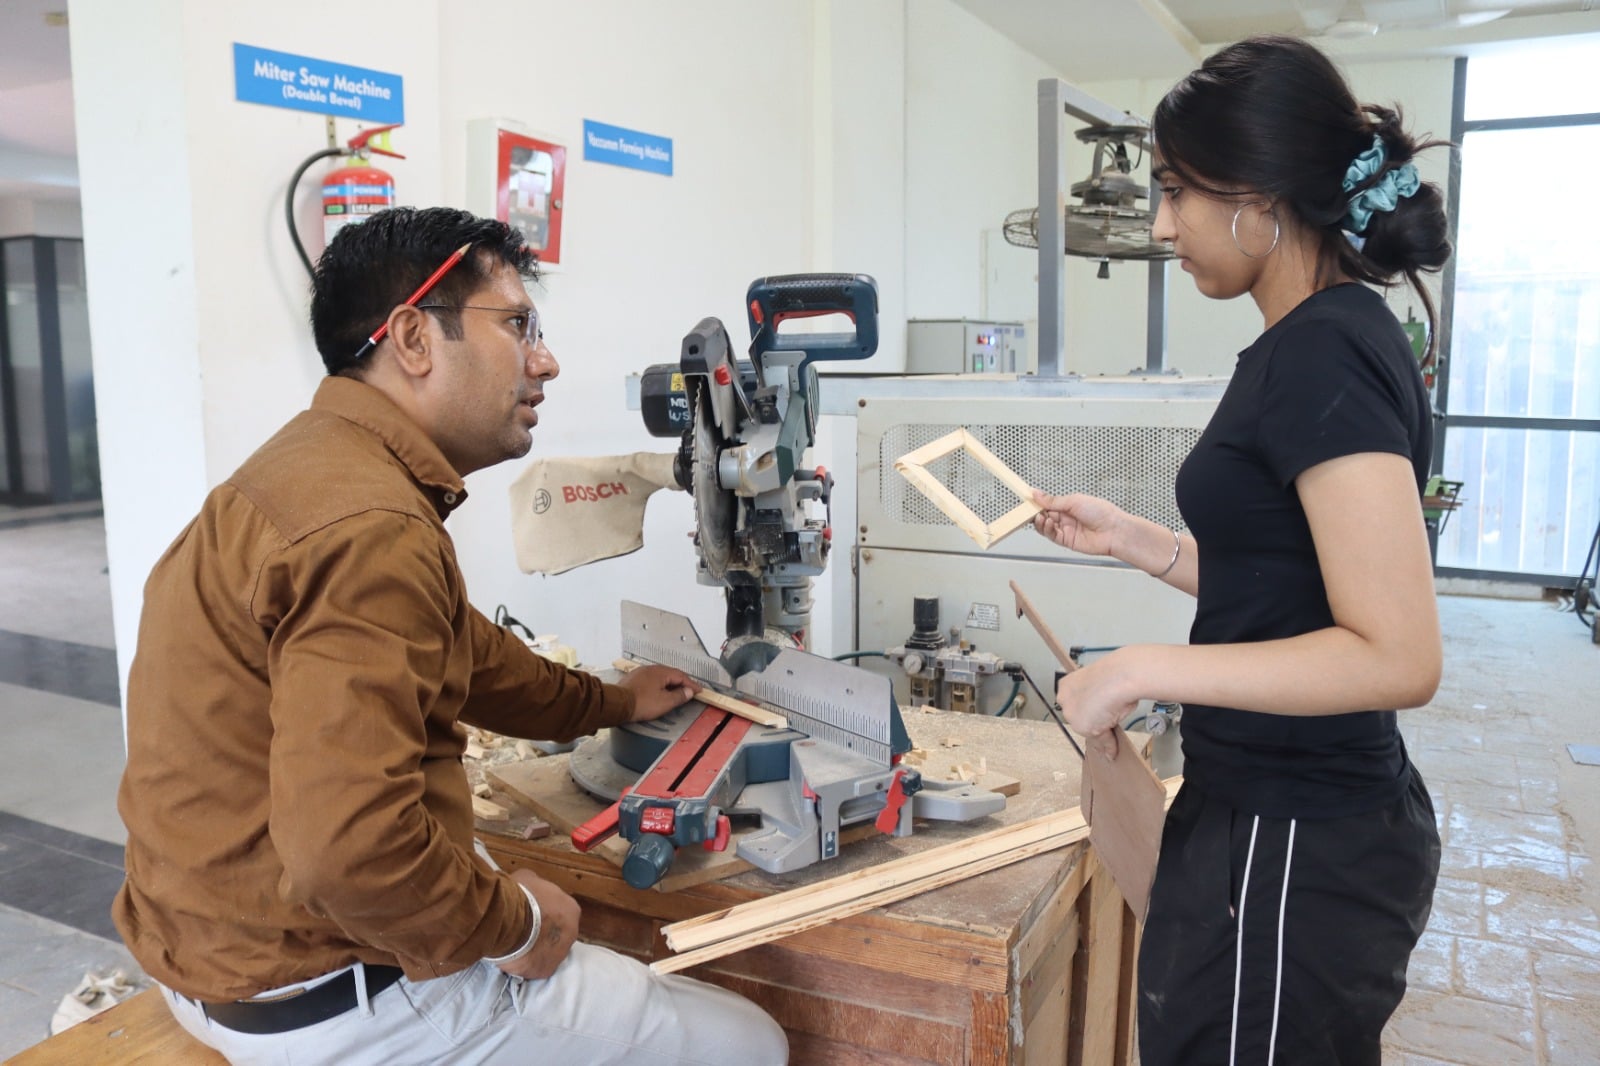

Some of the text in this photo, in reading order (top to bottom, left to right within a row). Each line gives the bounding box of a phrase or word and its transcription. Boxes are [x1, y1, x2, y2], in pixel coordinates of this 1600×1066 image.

[254, 59, 391, 99] Miter Saw Machine
[282, 85, 361, 110] (Double Bevel)
[562, 482, 628, 504] BOSCH
